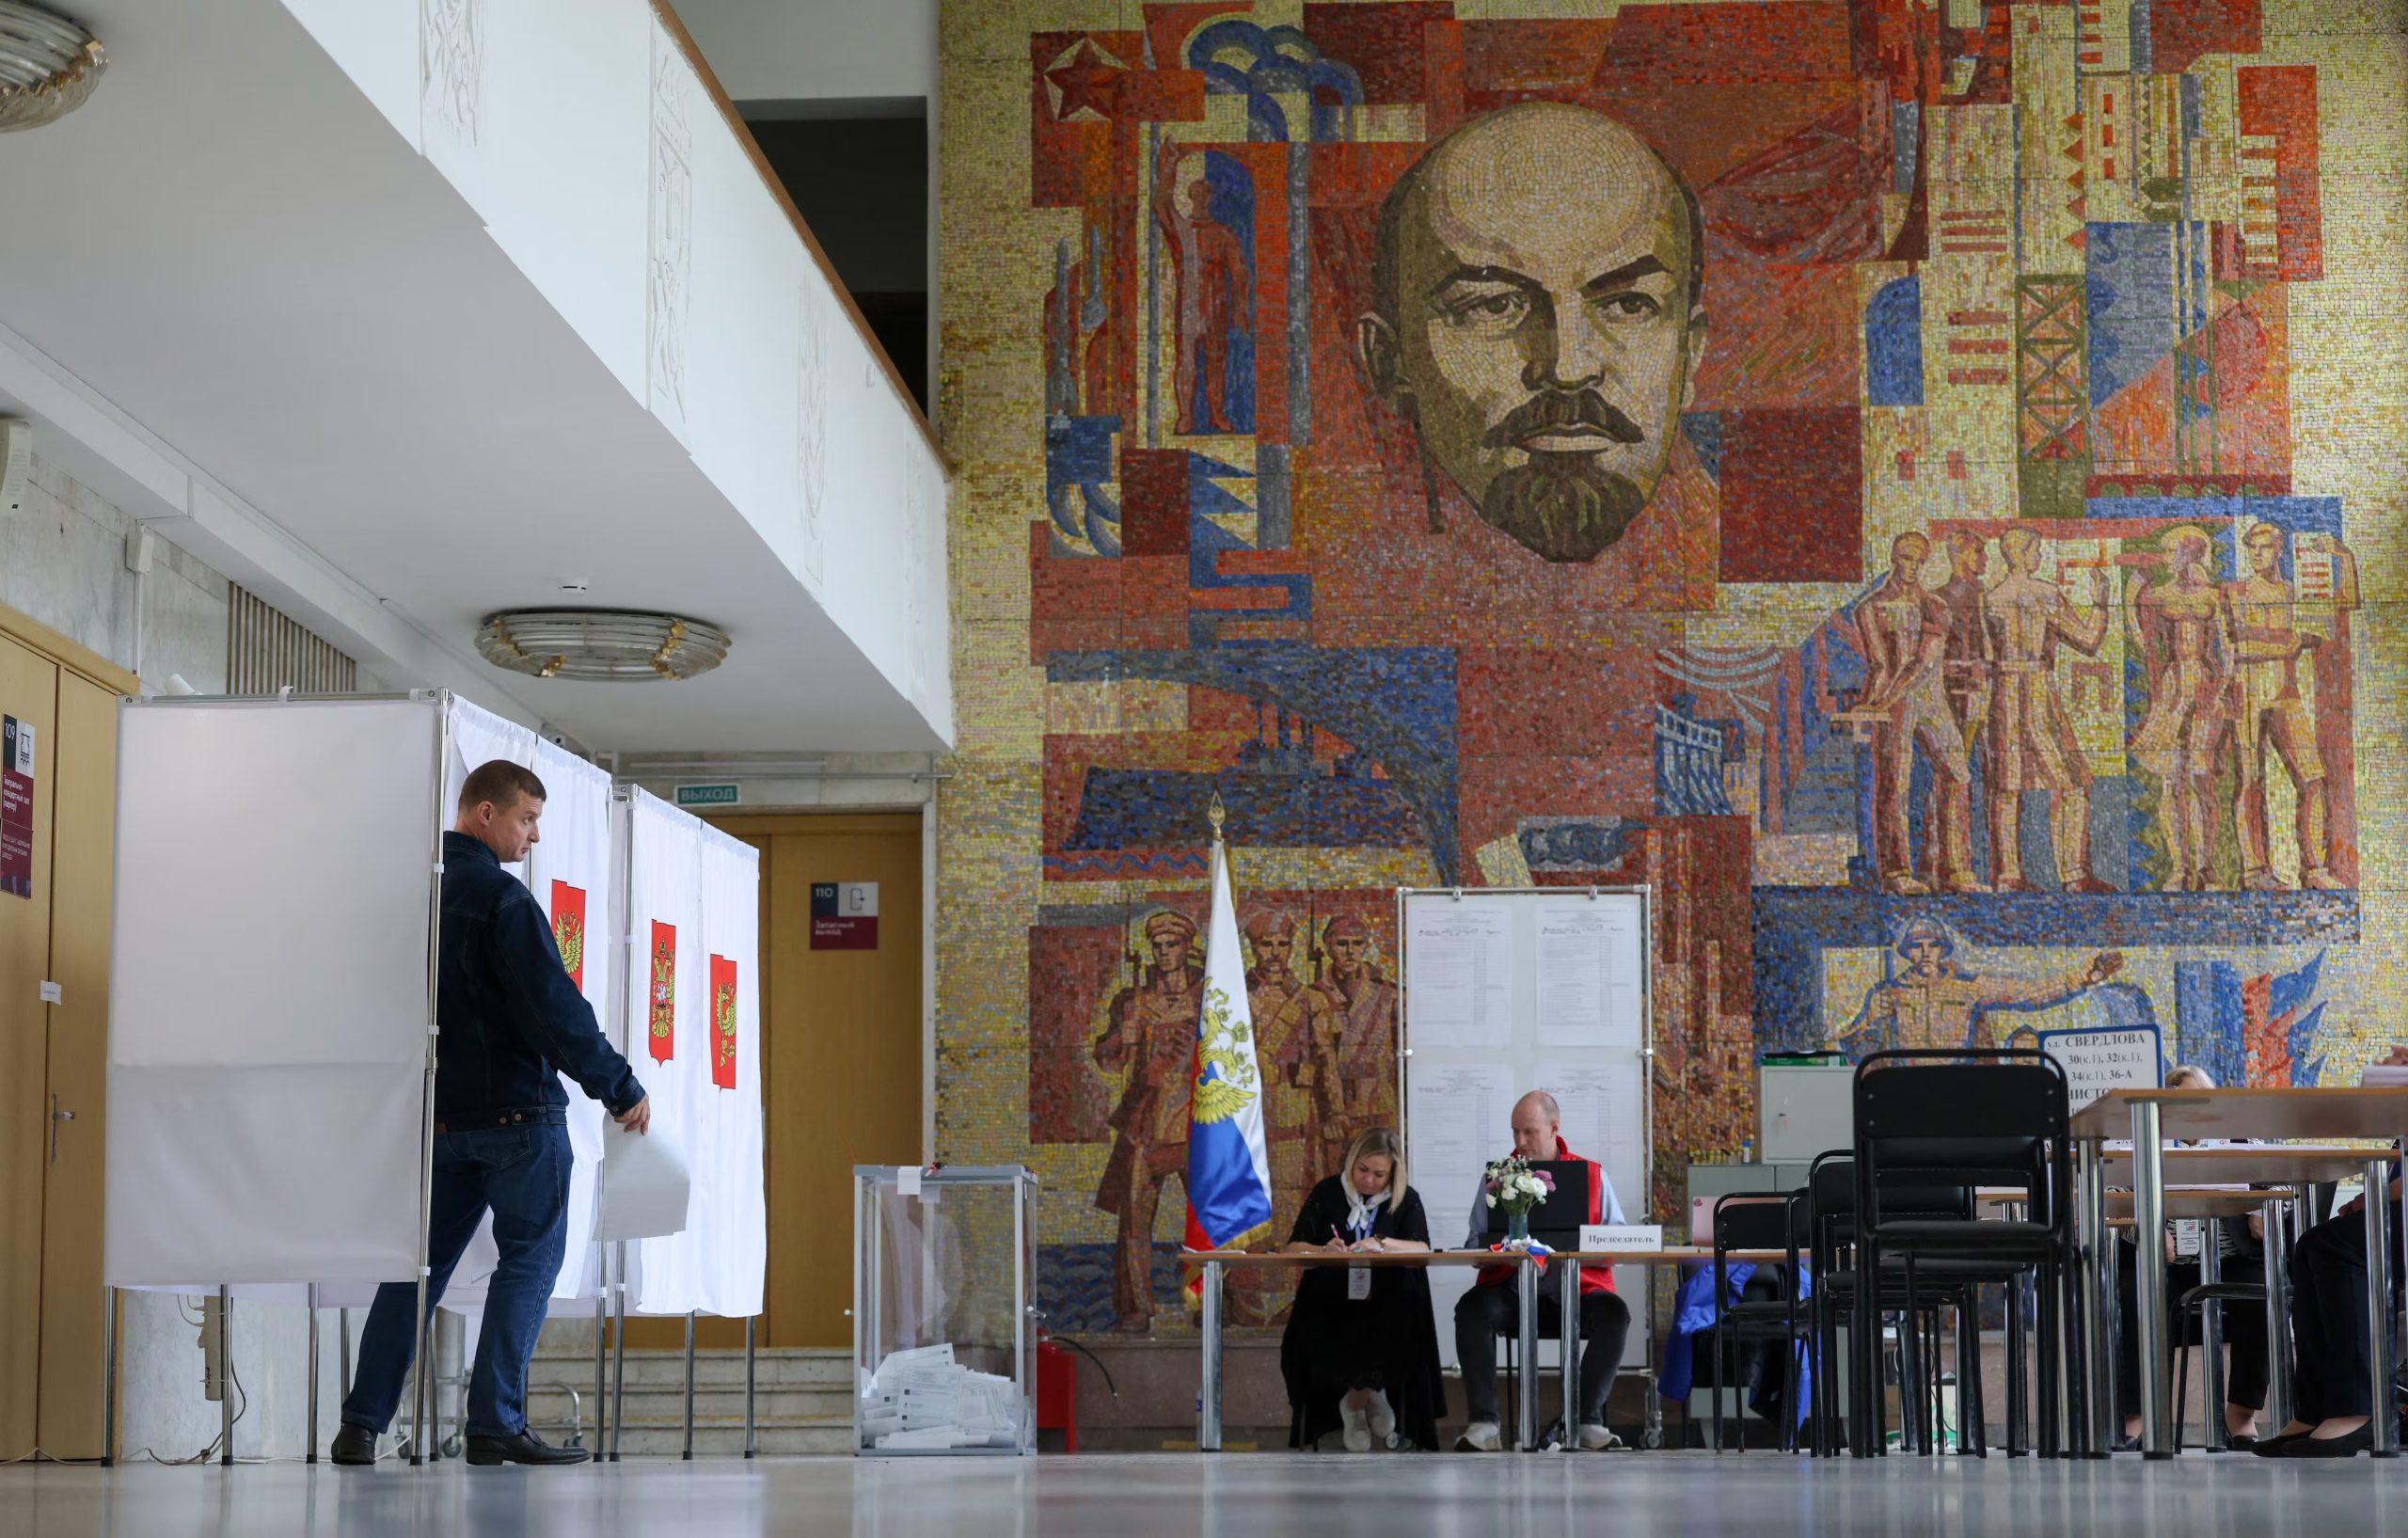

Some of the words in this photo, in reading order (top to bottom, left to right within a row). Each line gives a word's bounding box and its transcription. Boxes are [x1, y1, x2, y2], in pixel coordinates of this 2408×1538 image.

[5, 722, 16, 739] 109
[681, 788, 734, 801] ВЫХОД
[815, 887, 833, 897] 110
[2066, 1033, 2145, 1047] СВЕРДЛОВА
[2109, 1070, 2132, 1081] 36-А
[1588, 1234, 1656, 1245] Председатель
